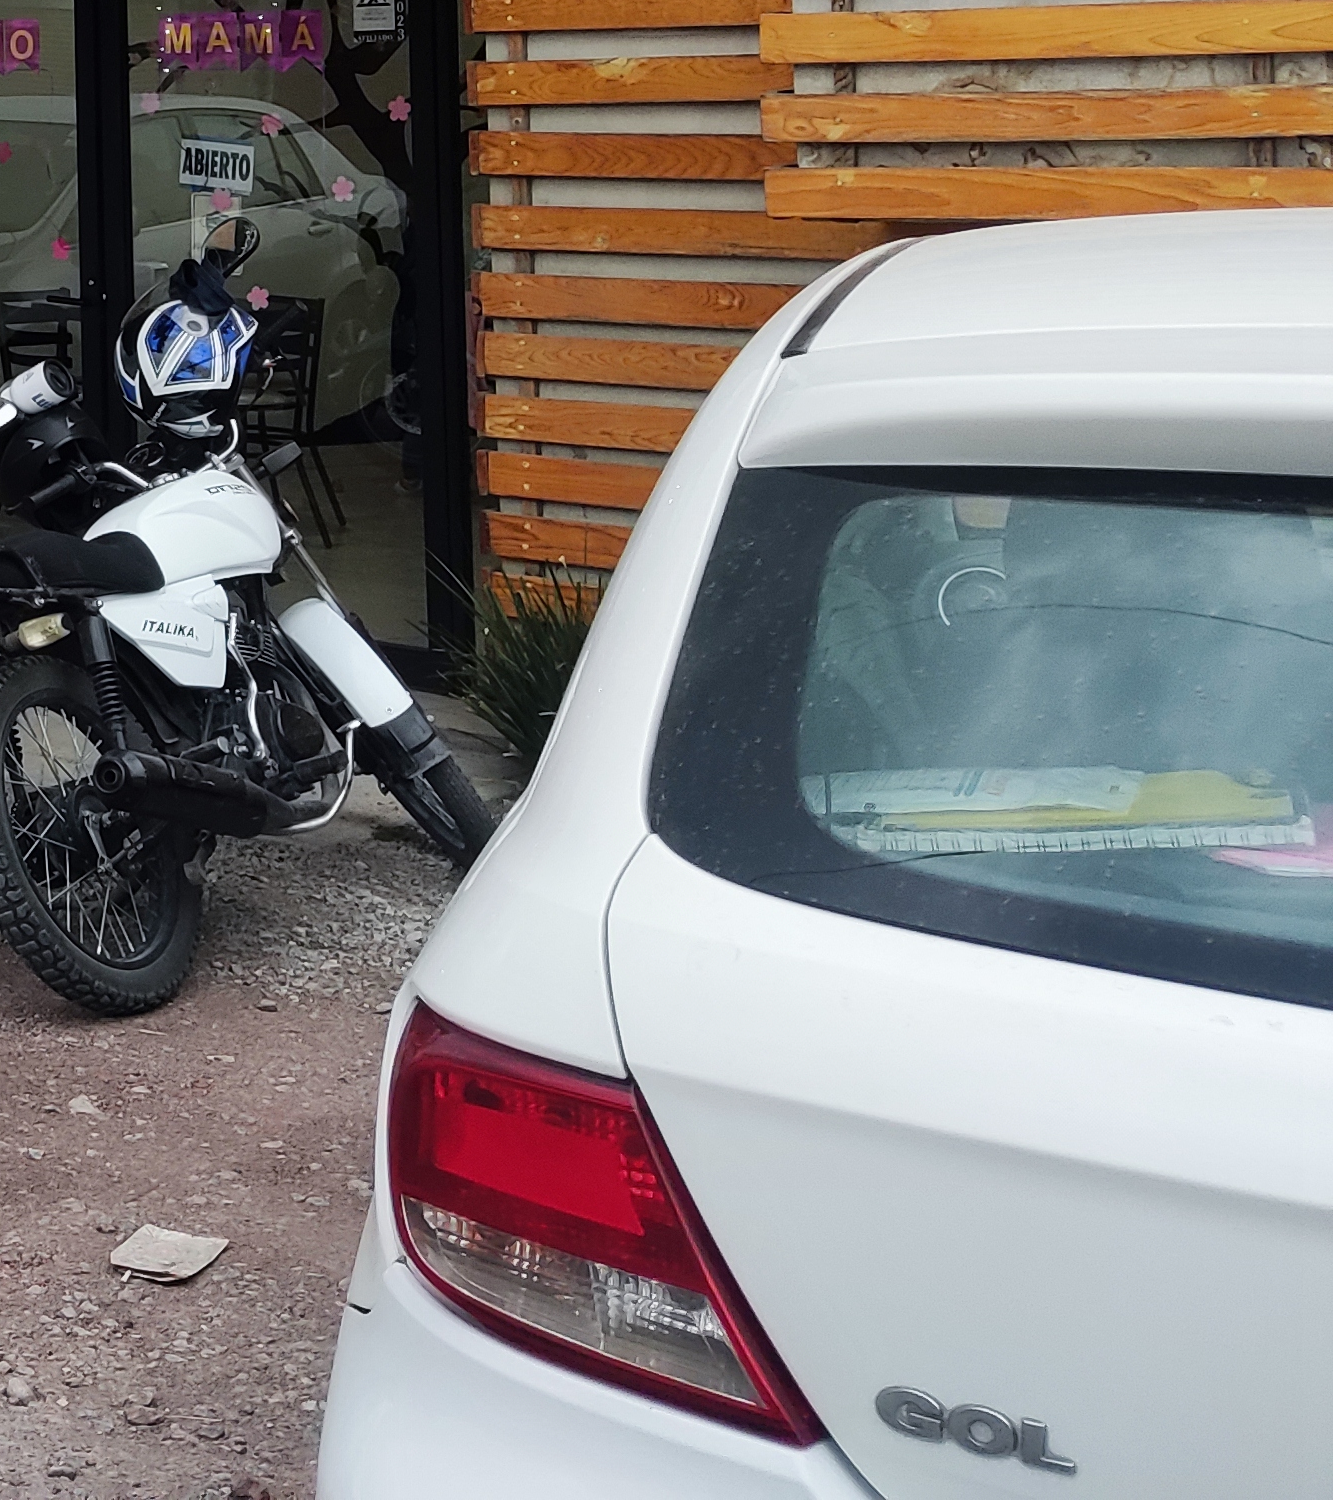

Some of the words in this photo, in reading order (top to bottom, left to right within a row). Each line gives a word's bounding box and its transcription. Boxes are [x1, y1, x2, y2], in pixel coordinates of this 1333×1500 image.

[164, 15, 315, 55] MAMÁ
[181, 146, 251, 181] ABIERTO
[142, 619, 195, 639] ITALIKA
[874, 1384, 1078, 1476] GOL
